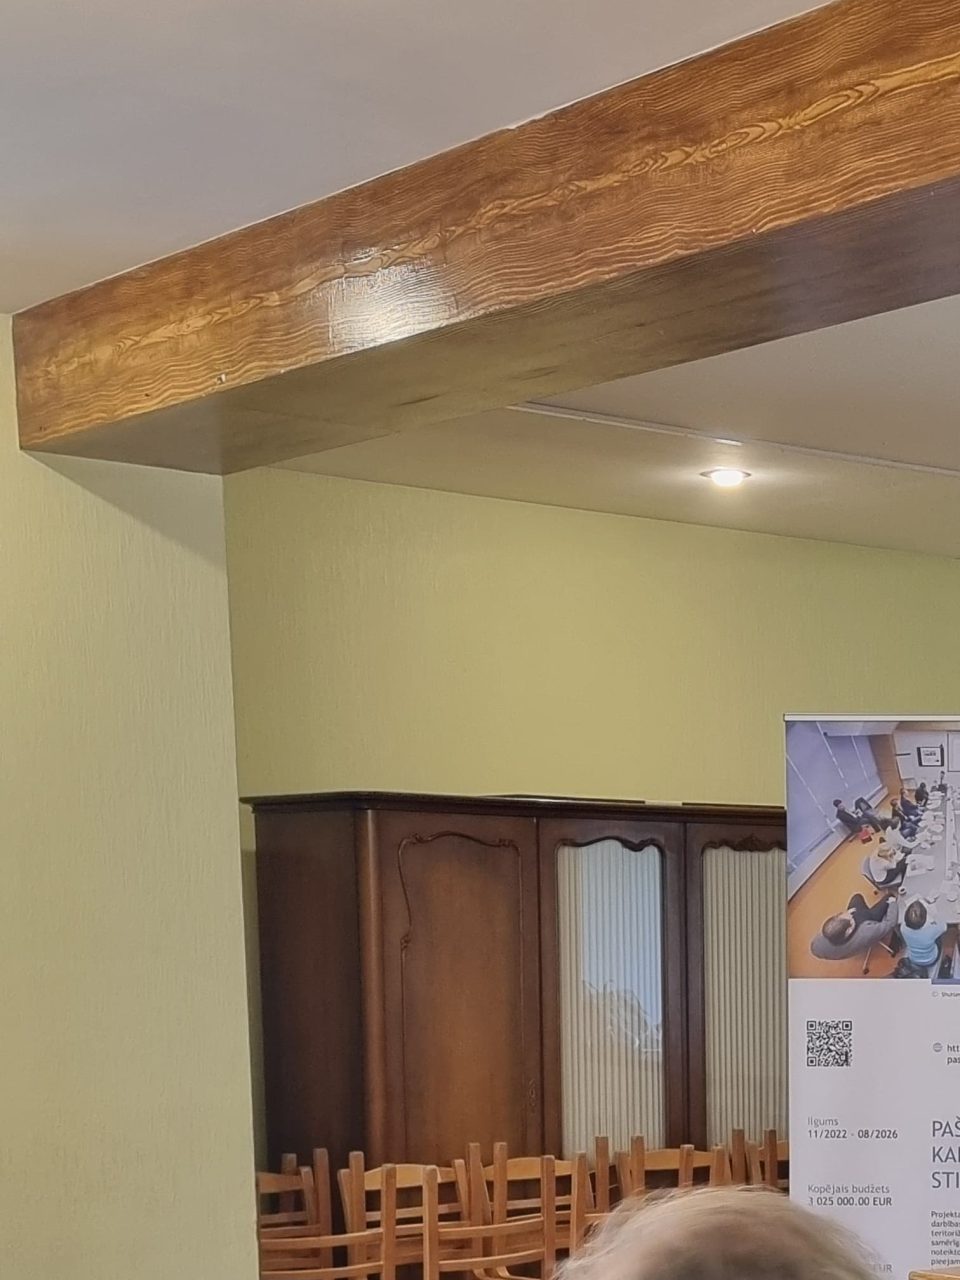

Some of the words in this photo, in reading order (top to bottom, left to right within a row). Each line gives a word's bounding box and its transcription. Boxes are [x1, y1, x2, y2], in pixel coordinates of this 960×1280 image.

[808, 1116, 839, 1128] Ilgums
[808, 1129, 848, 1139] 11/2022
[857, 1129, 898, 1139] 08/2026
[808, 1184, 849, 1195] Kopējais
[851, 1184, 890, 1194] budžets
[816, 1197, 834, 1206] 025
[836, 1197, 870, 1206] 000.00
[873, 1197, 893, 1206] EUR
